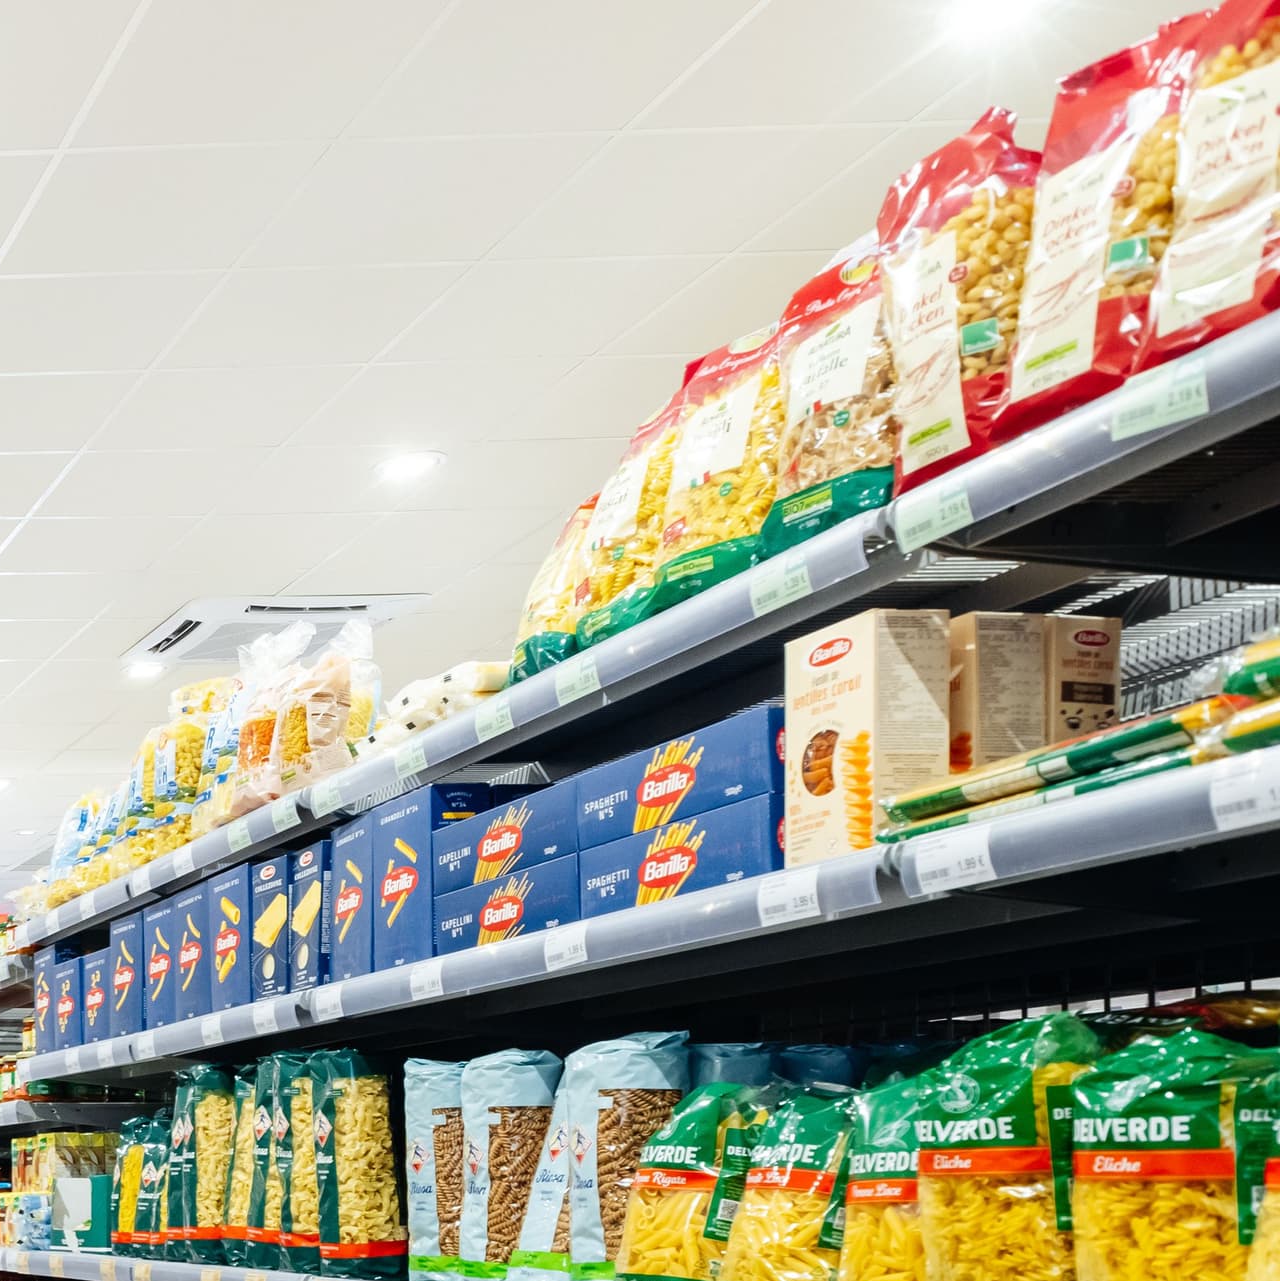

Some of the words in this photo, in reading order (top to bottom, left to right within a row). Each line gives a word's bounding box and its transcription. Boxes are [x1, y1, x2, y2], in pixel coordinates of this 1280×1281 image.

[642, 772, 689, 803] Barilla
[584, 790, 628, 817] SPAGHETTI
[481, 832, 519, 857] Barilla
[645, 852, 690, 882] Barilla
[383, 873, 415, 895] Barilla
[587, 868, 630, 891] SPAGHETTI
[483, 902, 522, 924] Barilla
[933, 1153, 972, 1169] Eliche
[1094, 1156, 1141, 1173] Eliche
